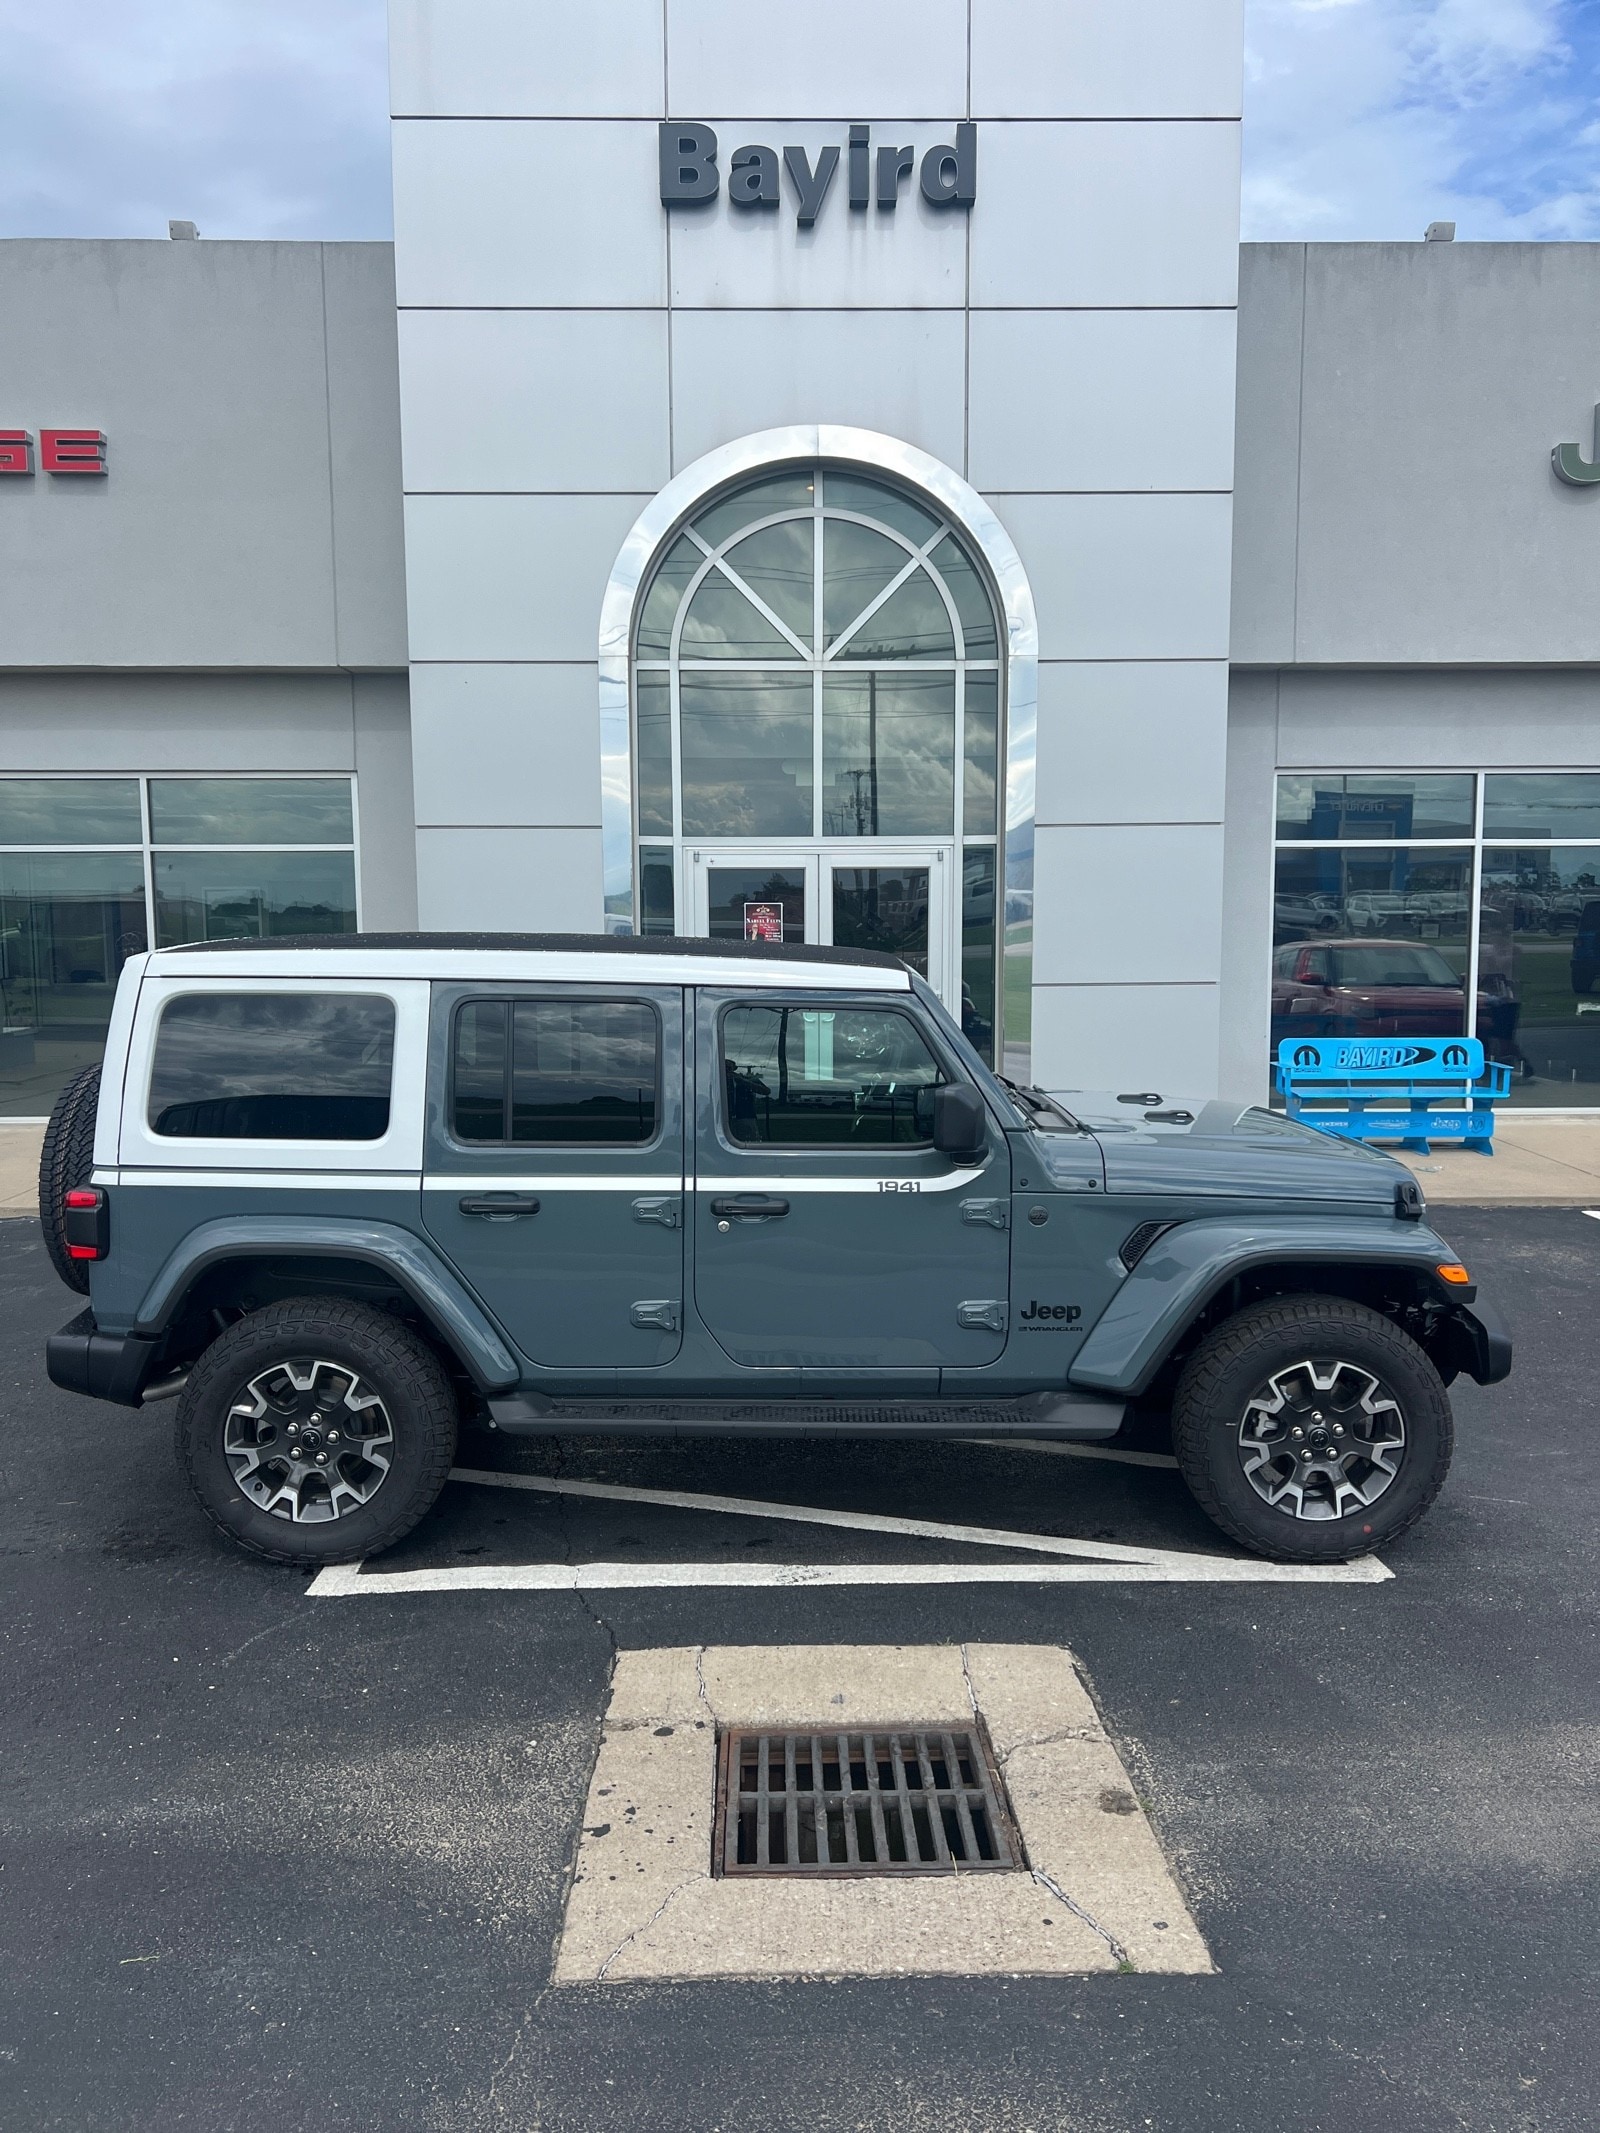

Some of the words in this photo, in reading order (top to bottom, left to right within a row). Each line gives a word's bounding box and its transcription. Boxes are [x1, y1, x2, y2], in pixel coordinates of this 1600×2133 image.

[659, 122, 977, 226] Bayird
[1336, 1047, 1406, 1067] BAYIRD
[1431, 1117, 1462, 1130] Jeep
[877, 1181, 921, 1193] 1941
[1021, 1300, 1081, 1323] Jeep
